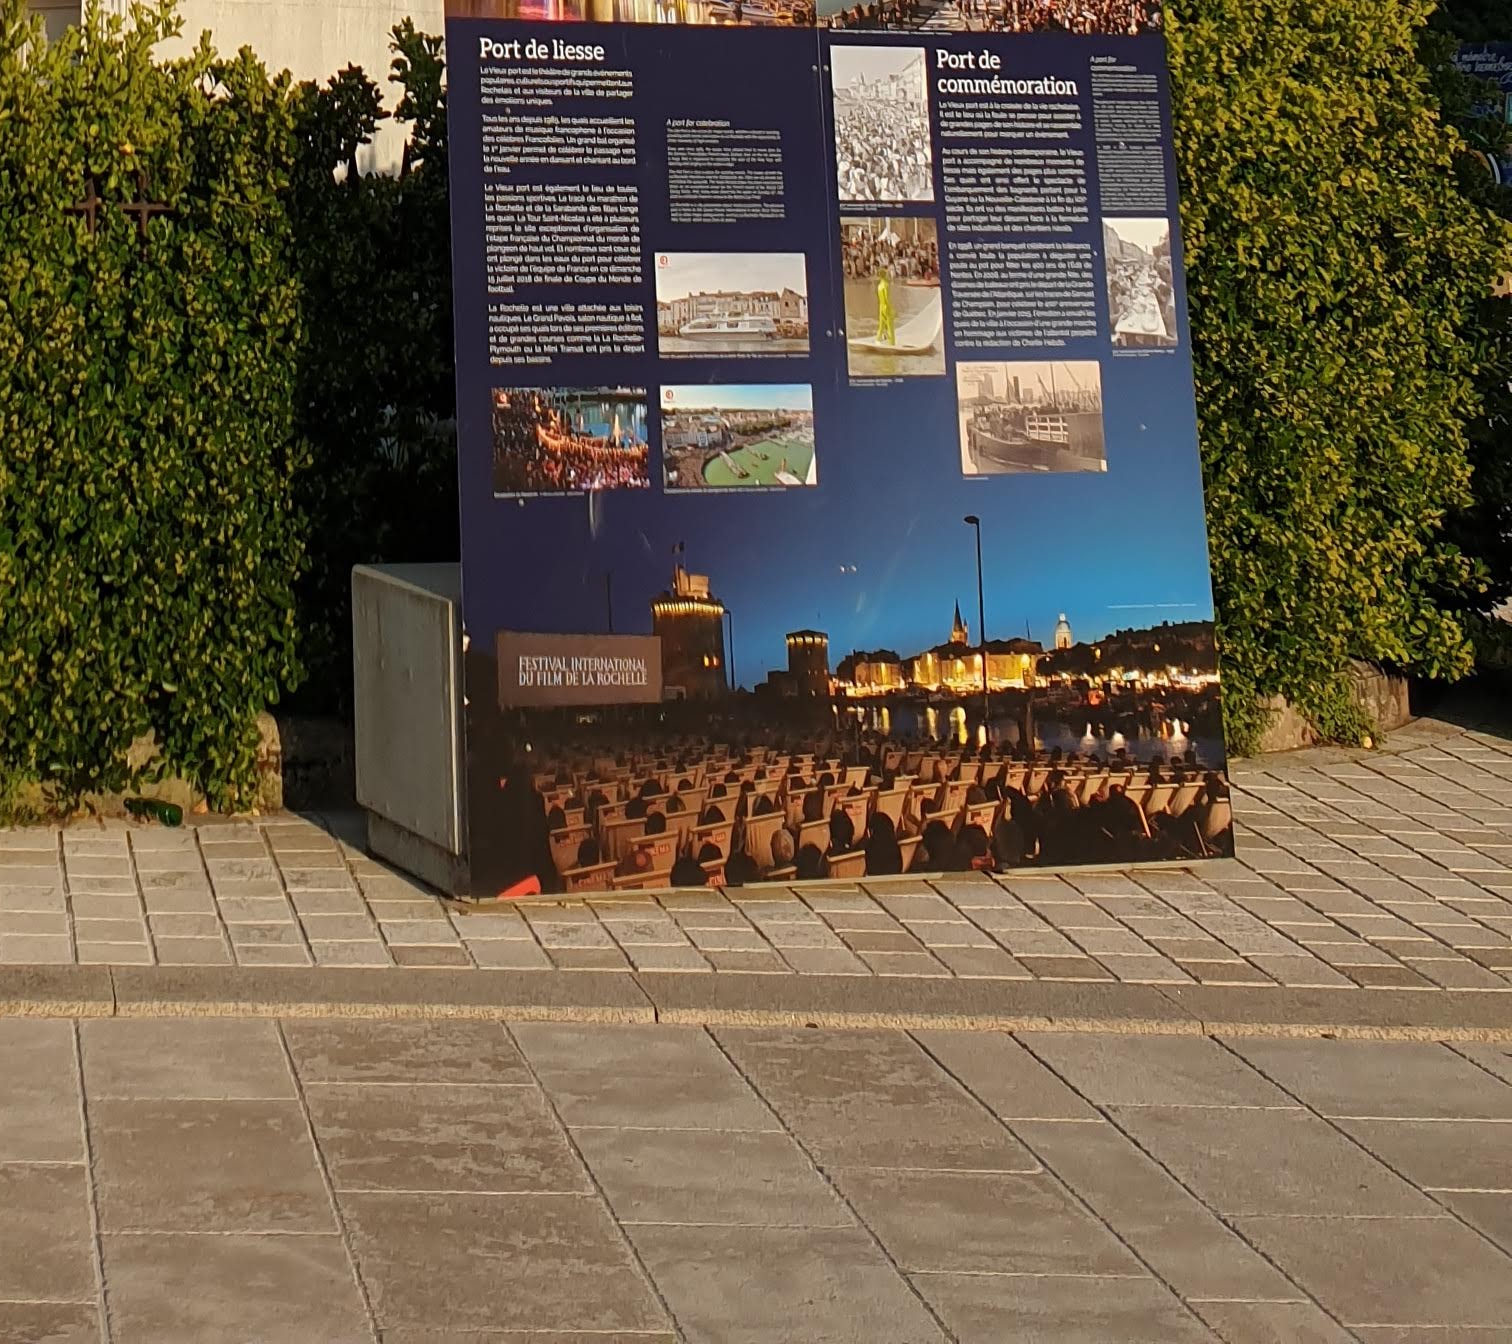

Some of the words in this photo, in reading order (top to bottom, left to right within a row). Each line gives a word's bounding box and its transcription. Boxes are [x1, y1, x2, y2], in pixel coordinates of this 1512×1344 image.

[480, 38, 521, 58] Port
[525, 39, 548, 59] de
[553, 39, 605, 61] liesse
[936, 49, 976, 69] Port
[979, 50, 1001, 69] de
[937, 75, 1079, 96] commémoration
[519, 656, 569, 672] FESTIVAL
[571, 657, 647, 672] INTERNATIONAL
[519, 672, 533, 686] DU
[537, 672, 562, 686] FILM
[566, 672, 579, 686] DE
[582, 672, 595, 686] LA
[597, 672, 648, 686] ROCHELLE
